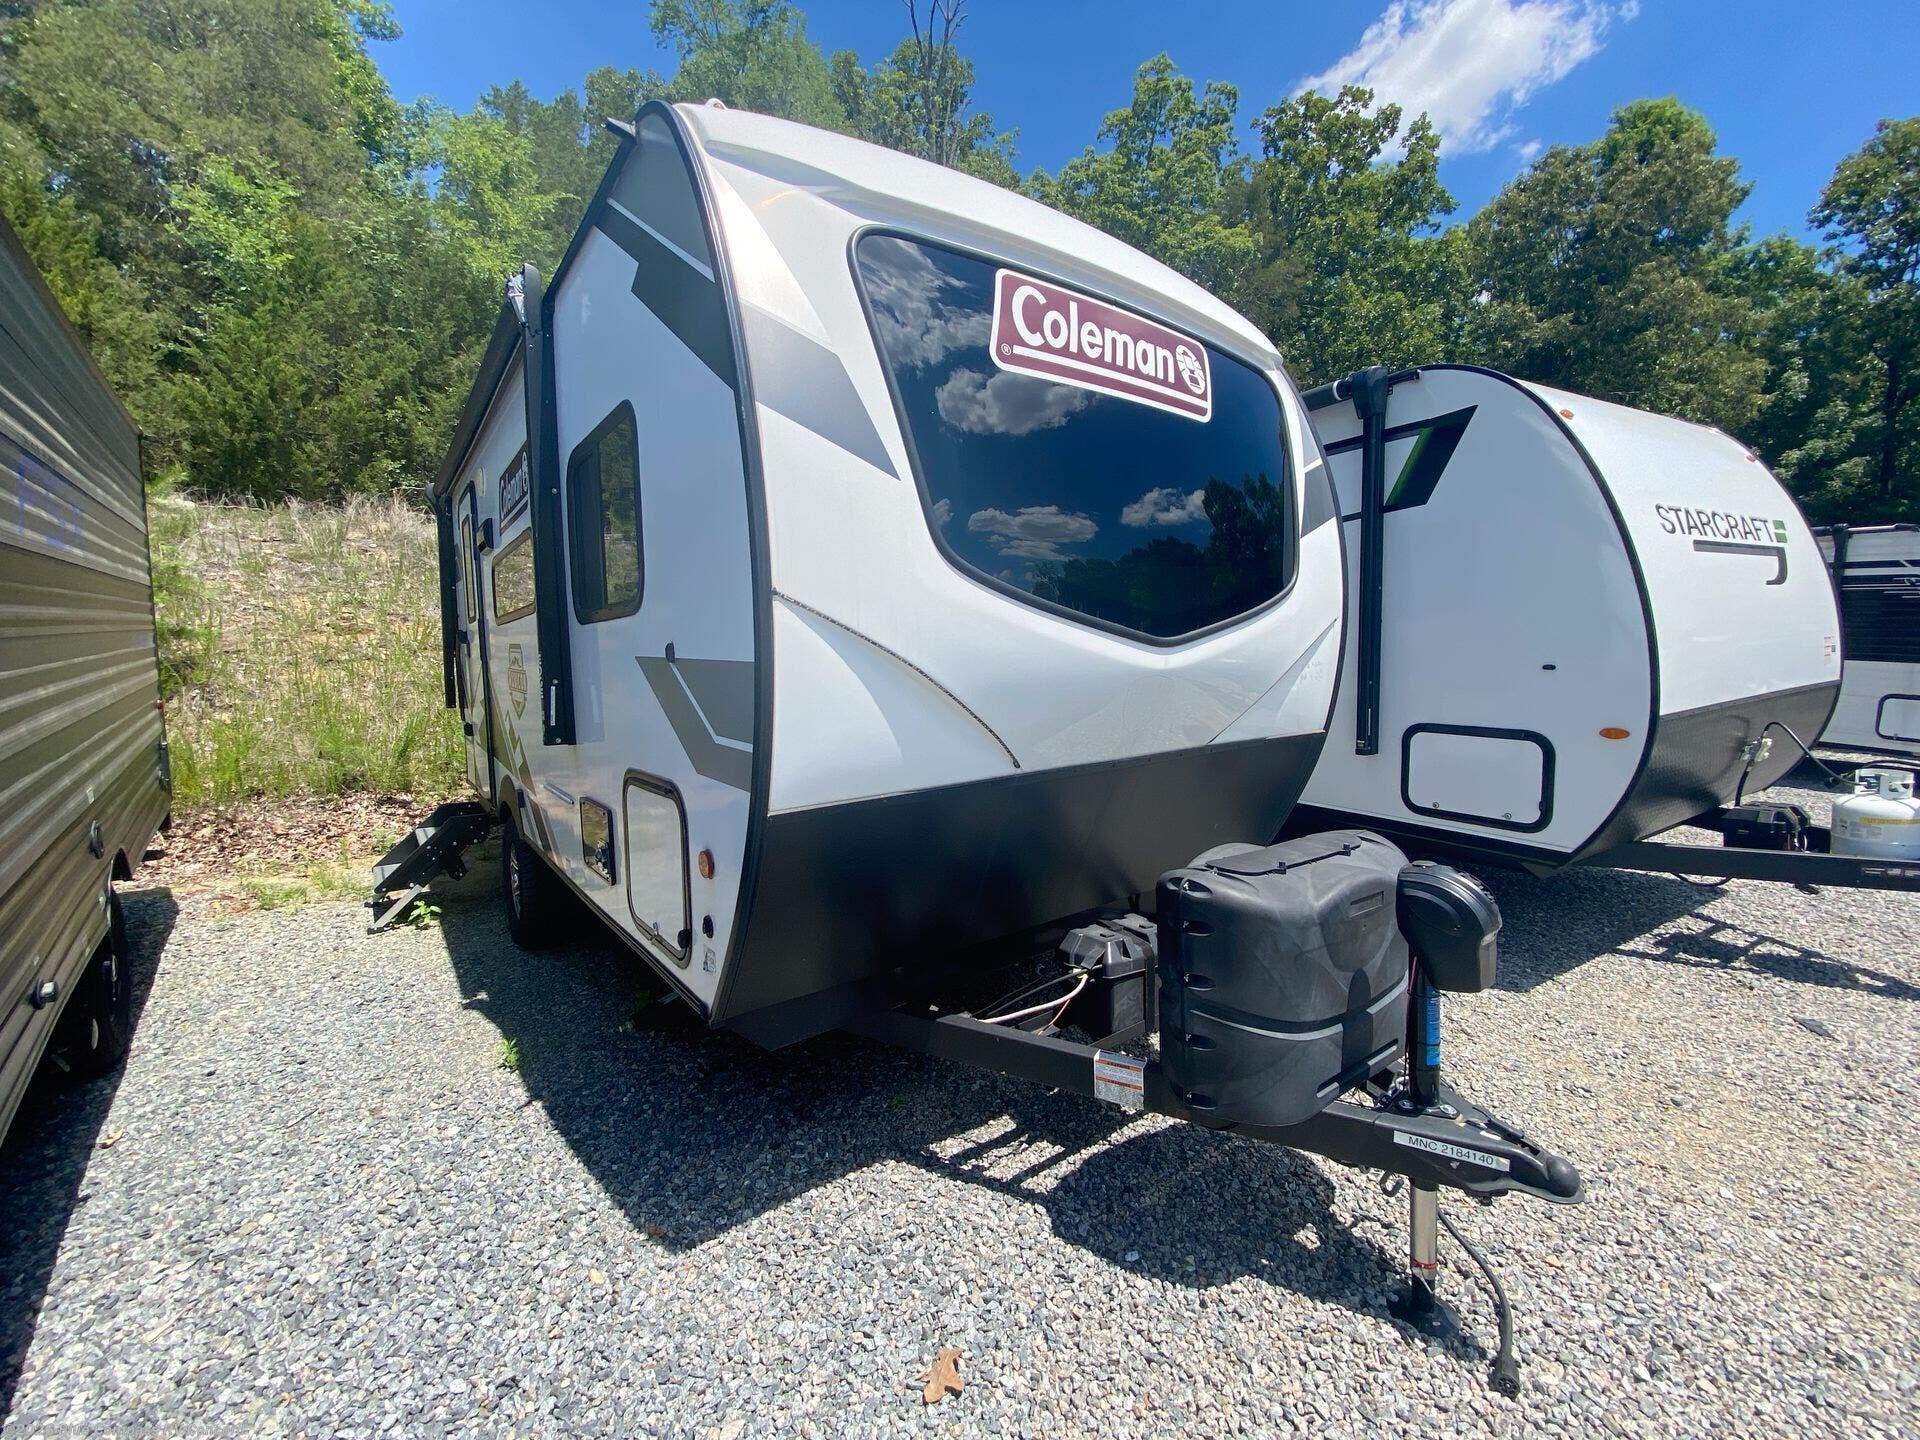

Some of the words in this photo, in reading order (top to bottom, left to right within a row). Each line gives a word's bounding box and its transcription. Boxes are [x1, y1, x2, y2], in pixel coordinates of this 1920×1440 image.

[1011, 285, 1175, 384] Coleman
[1655, 503, 1774, 542] STARCRAFT
[1408, 1135, 1438, 1151] MNC
[1441, 1144, 1494, 1166] 2184140
